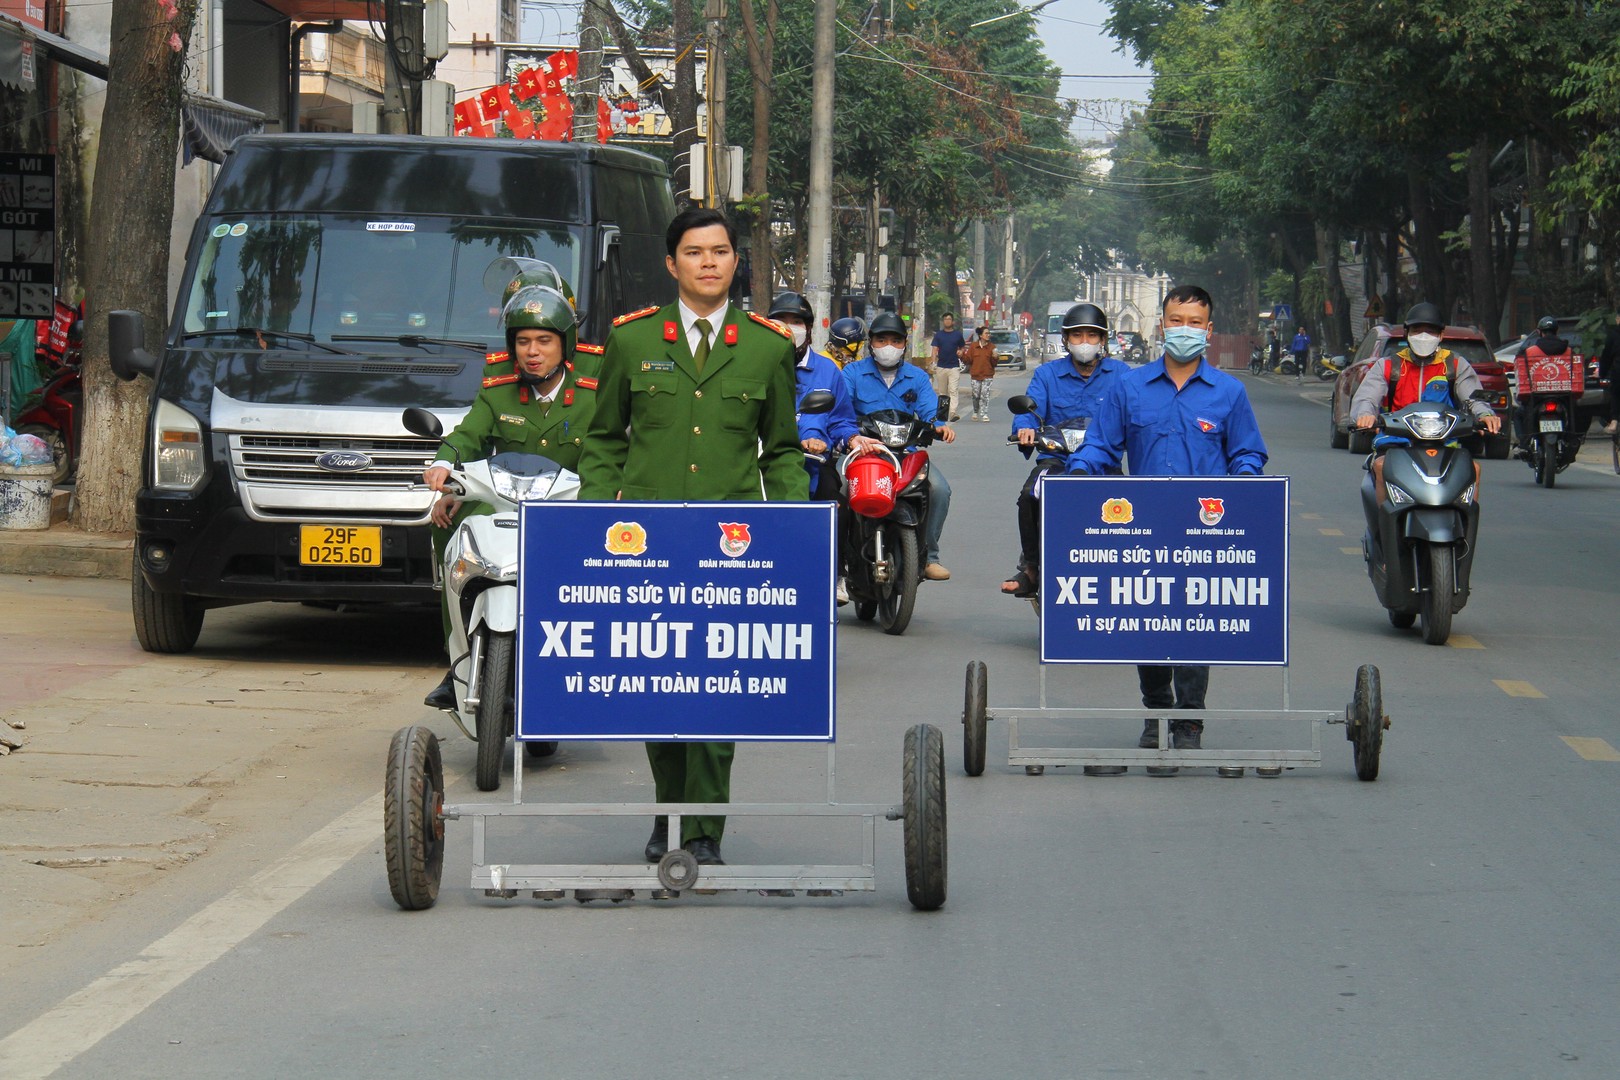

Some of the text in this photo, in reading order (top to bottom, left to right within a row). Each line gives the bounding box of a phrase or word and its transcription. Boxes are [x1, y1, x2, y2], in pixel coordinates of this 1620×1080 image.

[328, 454, 357, 467] Ford
[323, 528, 358, 544] 29F
[1084, 526, 1099, 535] CÔNG
[1131, 527, 1142, 535] LÀO
[1186, 528, 1201, 536] ĐOÀN
[1224, 527, 1235, 536] LÀO
[309, 546, 372, 563] 025.60
[583, 557, 669, 568] CÔNG AN PHƯỜNG LÀO CAI
[699, 557, 774, 569] ĐOÀN PHƯỜNG LÀO CAI
[1069, 544, 1256, 567] CHUNG SỨC VÌ CỘNG ĐỒNG
[558, 579, 797, 609] CHUNG SỨC VÌ CỘNG ĐỒNG
[1055, 568, 1269, 606] XE HÚT ĐINH
[1077, 613, 1250, 635] VÌ SỰ AN TOÀN CỦA BẠN
[538, 612, 813, 660] XE HÚT ĐINH
[565, 669, 787, 699] VÌ SỰ AN TOÀN CUẢ BẠN
